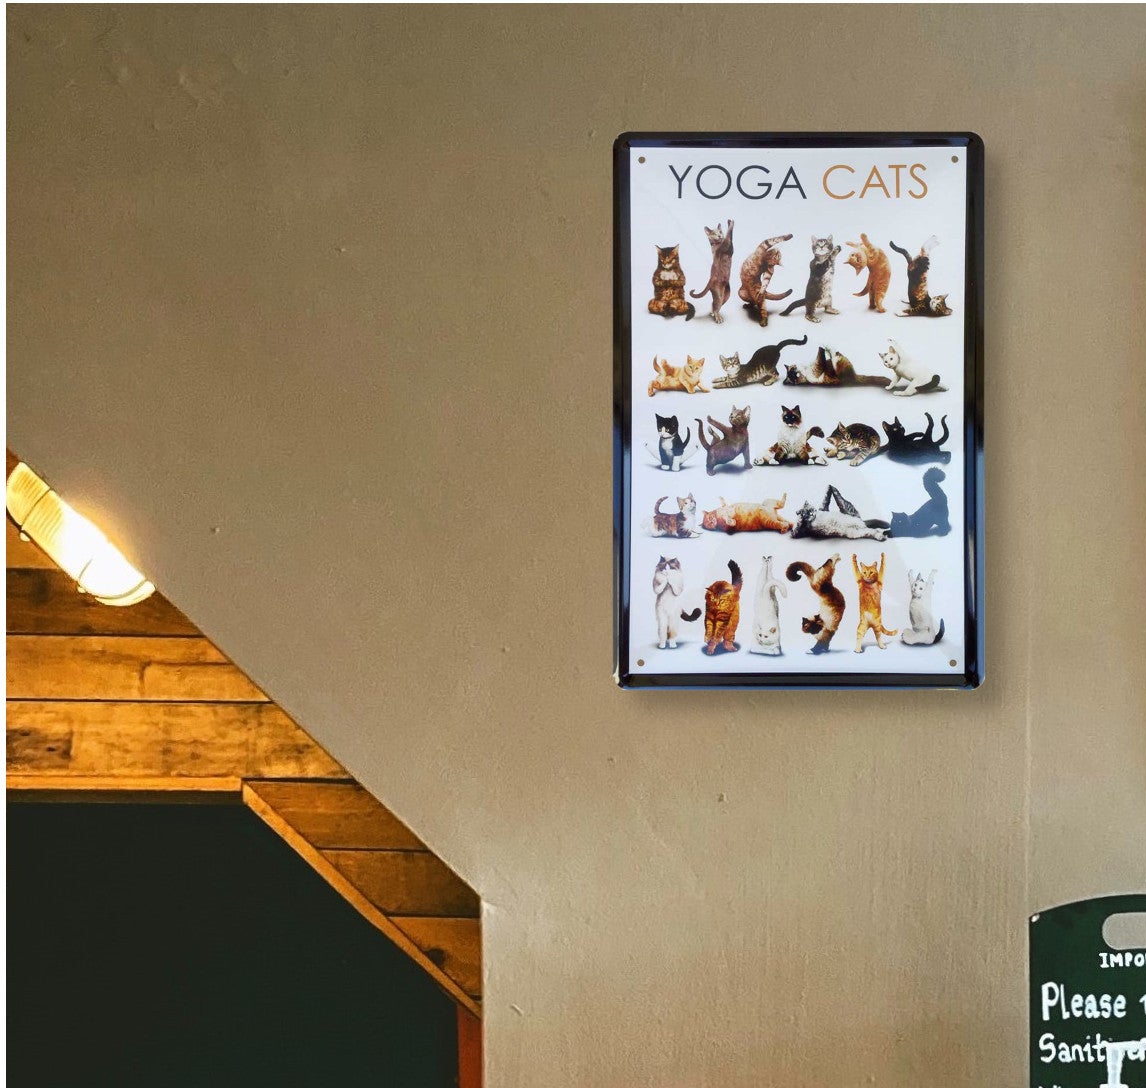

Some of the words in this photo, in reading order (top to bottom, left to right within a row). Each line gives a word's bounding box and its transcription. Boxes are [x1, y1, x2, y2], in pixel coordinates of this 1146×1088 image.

[668, 163, 807, 200] YOGA
[822, 163, 929, 200] CATS
[1041, 981, 1127, 1021] Please
